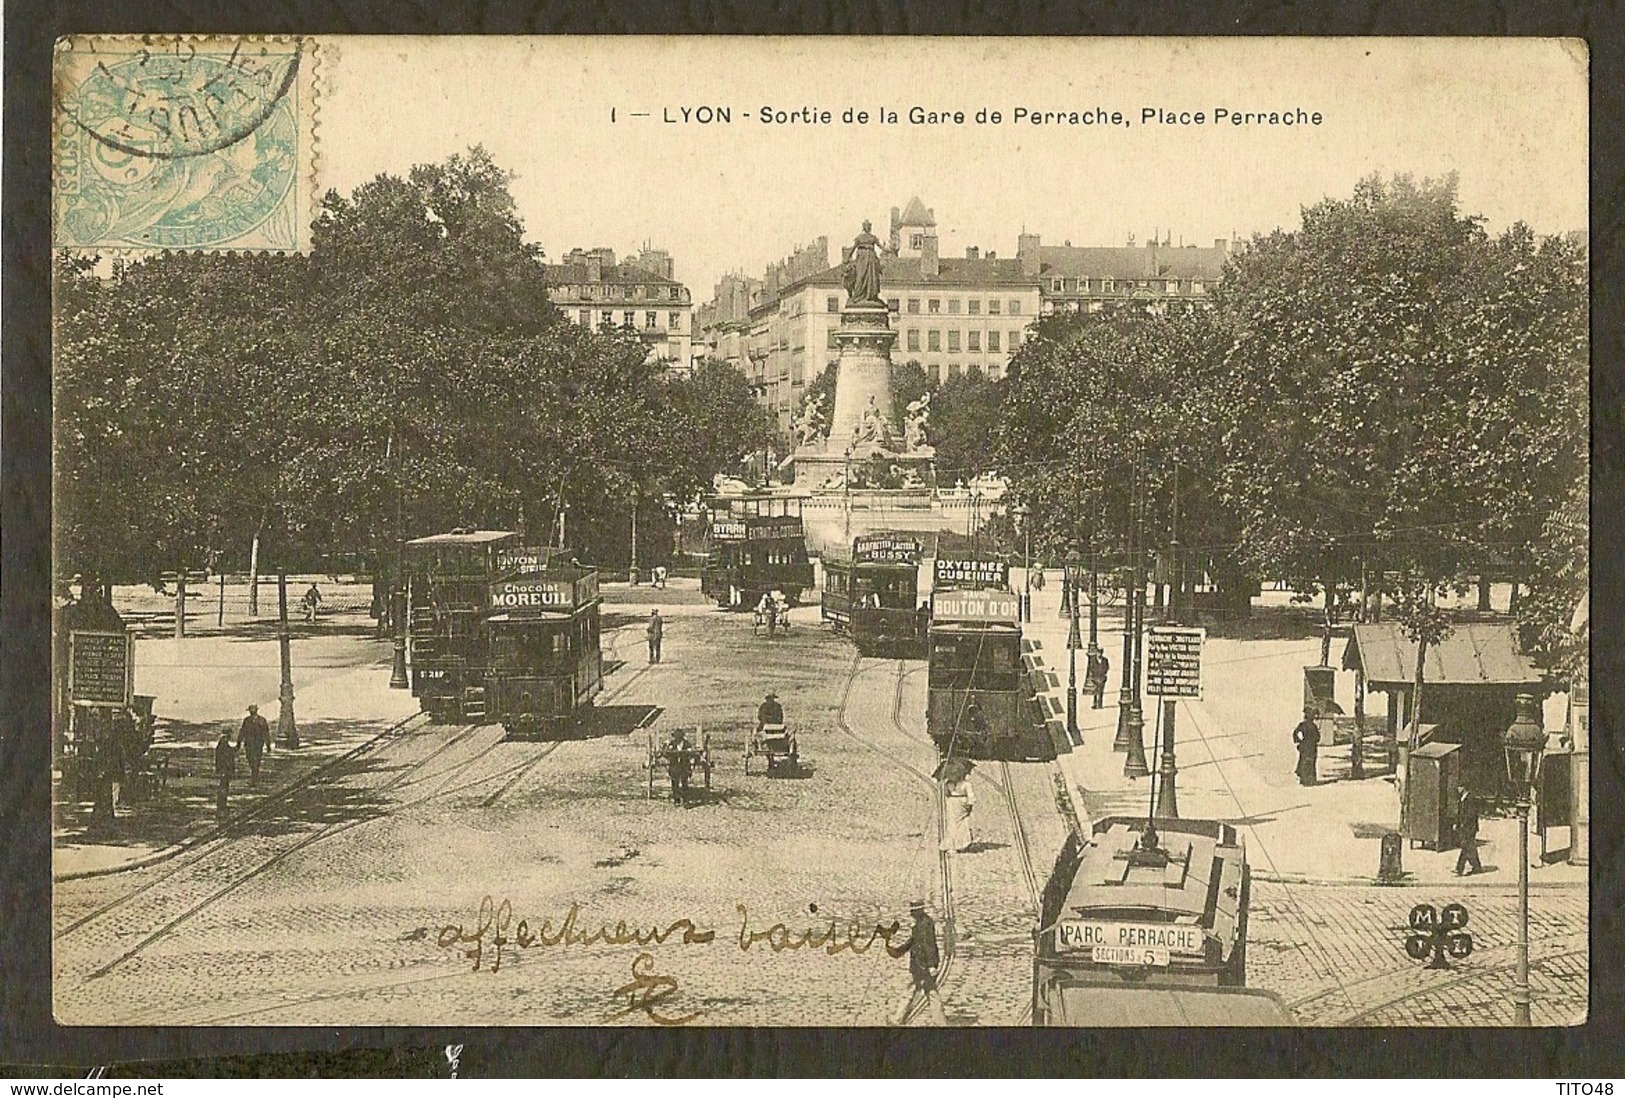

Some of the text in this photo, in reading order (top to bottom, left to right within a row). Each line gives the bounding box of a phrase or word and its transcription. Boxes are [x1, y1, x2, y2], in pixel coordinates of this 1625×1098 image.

[663, 106, 731, 124] LYON
[760, 106, 832, 124] Sortie
[842, 107, 869, 124] de
[880, 106, 898, 124] la
[909, 106, 965, 124] Gare
[975, 107, 1002, 124] de
[1014, 107, 1131, 128] Perrache,
[1141, 107, 1206, 124] Place
[1214, 107, 1323, 125] Perrache
[504, 583, 559, 593] Chocolat
[492, 592, 572, 606] MOREUIL
[935, 600, 1018, 617] BOUTON D'OR
[1119, 927, 1195, 948] PERRACHE
[1095, 947, 1135, 963] SECTIONS
[1143, 950, 1155, 966] 5
